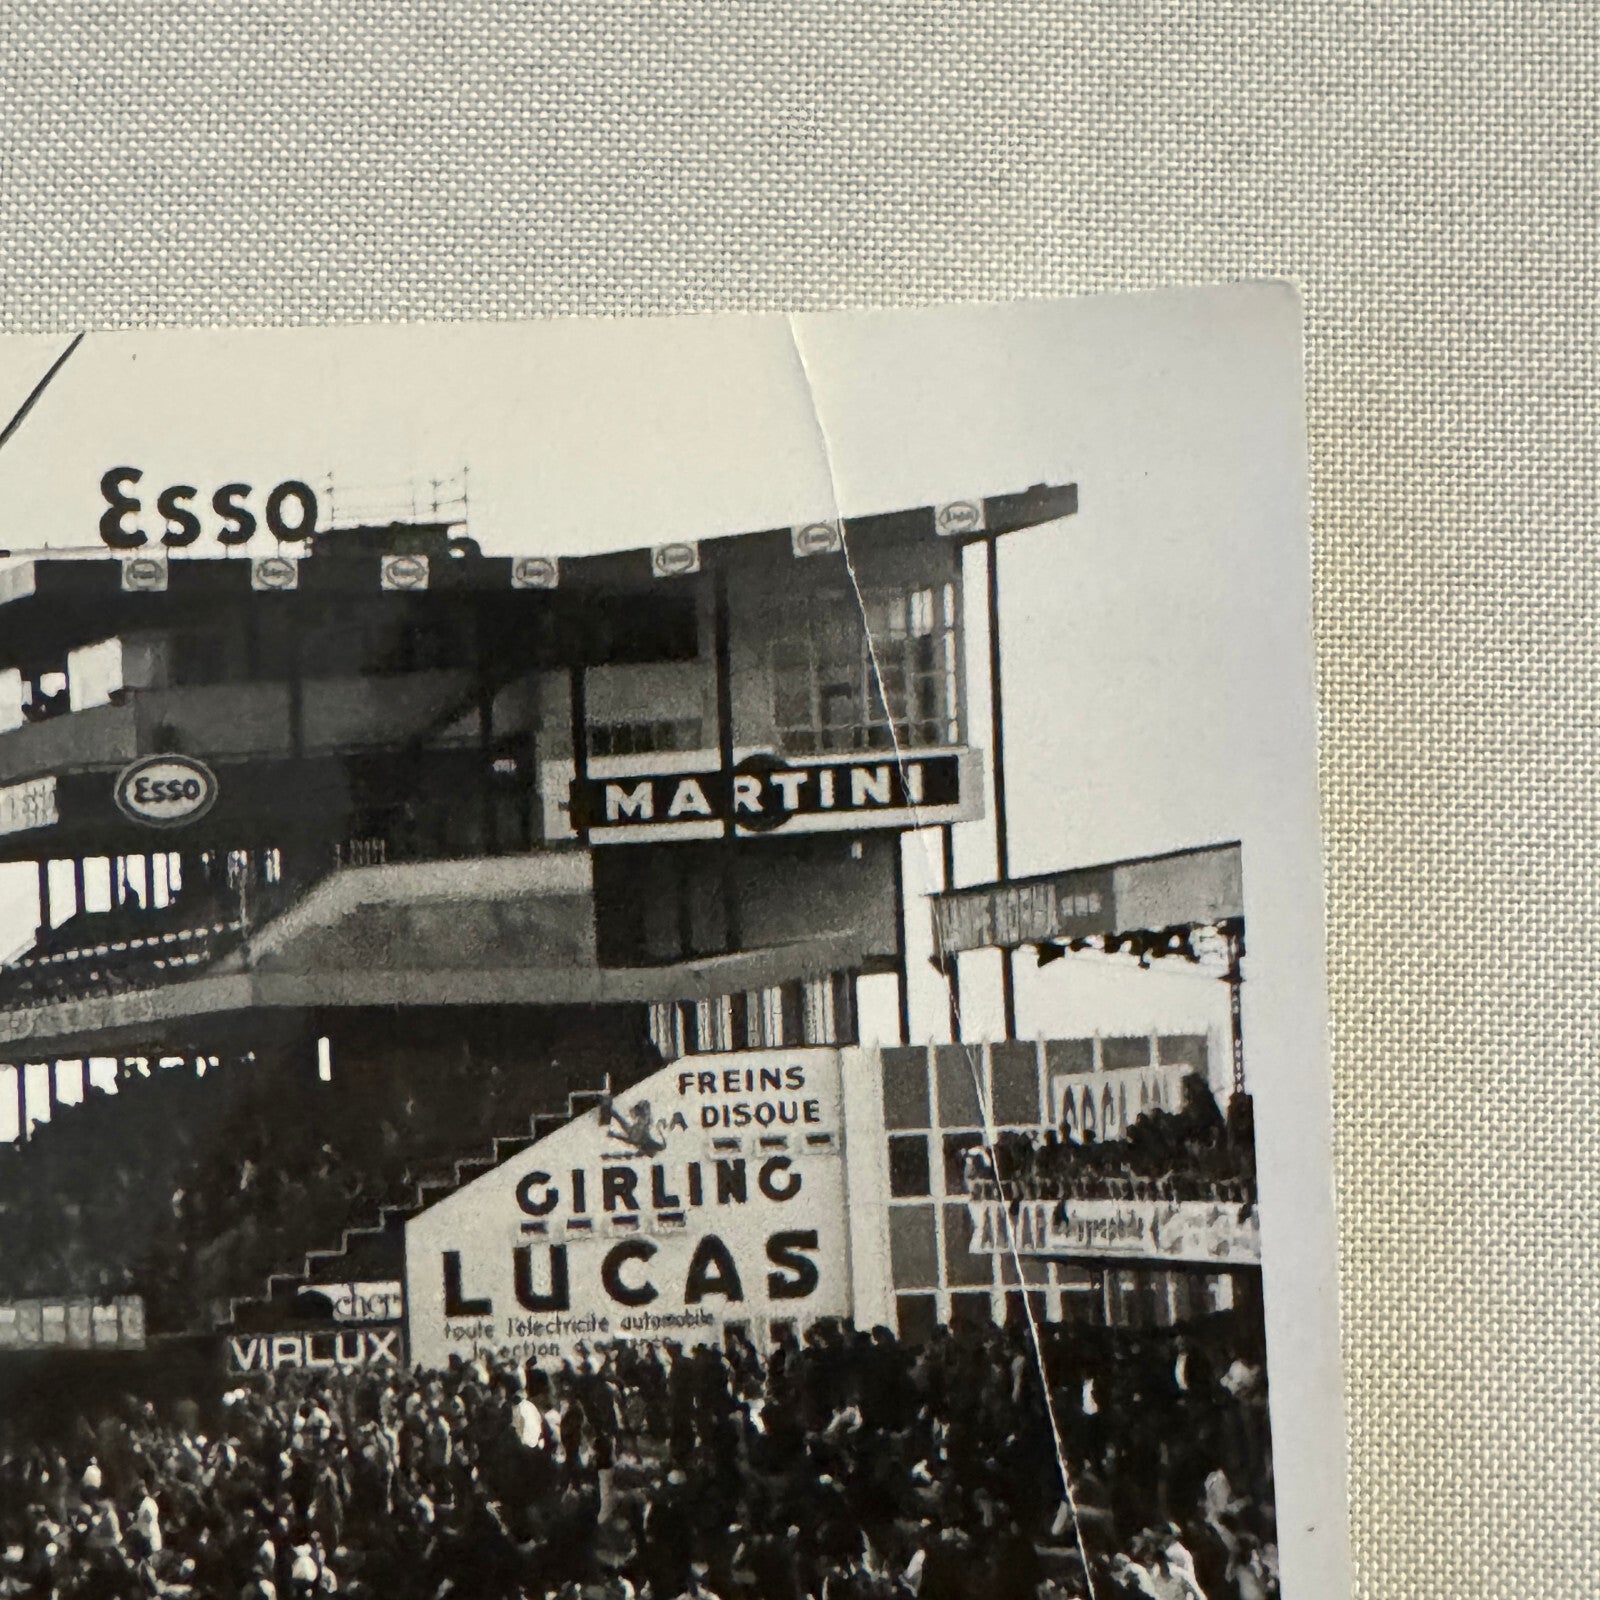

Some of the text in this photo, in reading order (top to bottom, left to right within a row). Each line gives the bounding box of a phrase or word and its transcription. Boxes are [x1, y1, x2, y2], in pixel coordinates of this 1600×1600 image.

[605, 765, 924, 822] MARTINI
[678, 1066, 806, 1095] FREINS
[701, 1100, 821, 1128] DISQUE
[515, 1156, 802, 1216] GIRLING
[442, 1229, 821, 1318] LUCAS
